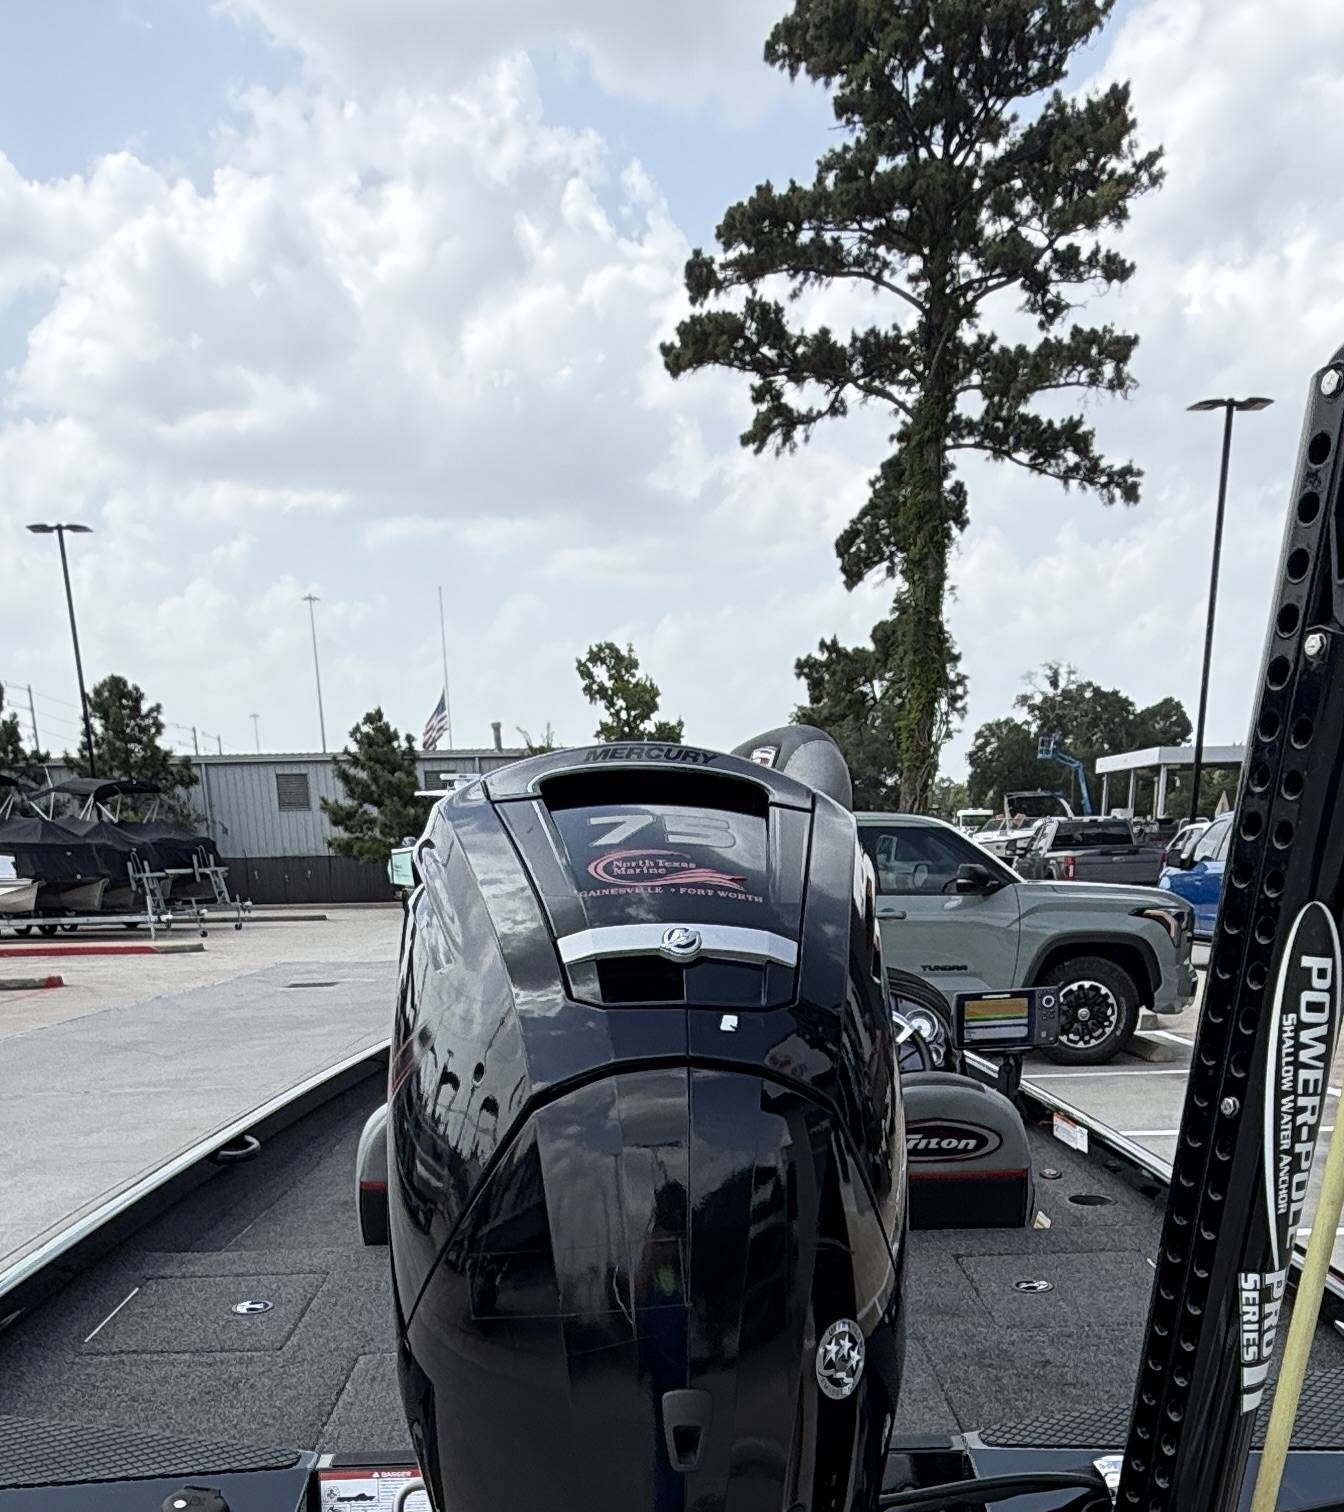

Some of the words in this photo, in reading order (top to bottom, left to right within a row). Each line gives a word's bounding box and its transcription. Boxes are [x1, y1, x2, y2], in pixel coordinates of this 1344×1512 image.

[584, 748, 719, 764] MERCURY
[588, 814, 737, 848] 75
[612, 859, 654, 869] North
[656, 859, 697, 869] Texas
[612, 867, 667, 875] Marine
[577, 886, 664, 898] GAINESVILLE
[679, 887, 715, 896] FORT
[716, 890, 764, 903] WORTH
[920, 963, 969, 973] TUNDRA
[1281, 1012, 1298, 1092] SHALLOW
[1279, 1094, 1296, 1151] WATER
[1277, 1153, 1293, 1216] ANCHOR
[1240, 1271, 1262, 1363] SERIES
[1261, 1269, 1287, 1362] PRO
